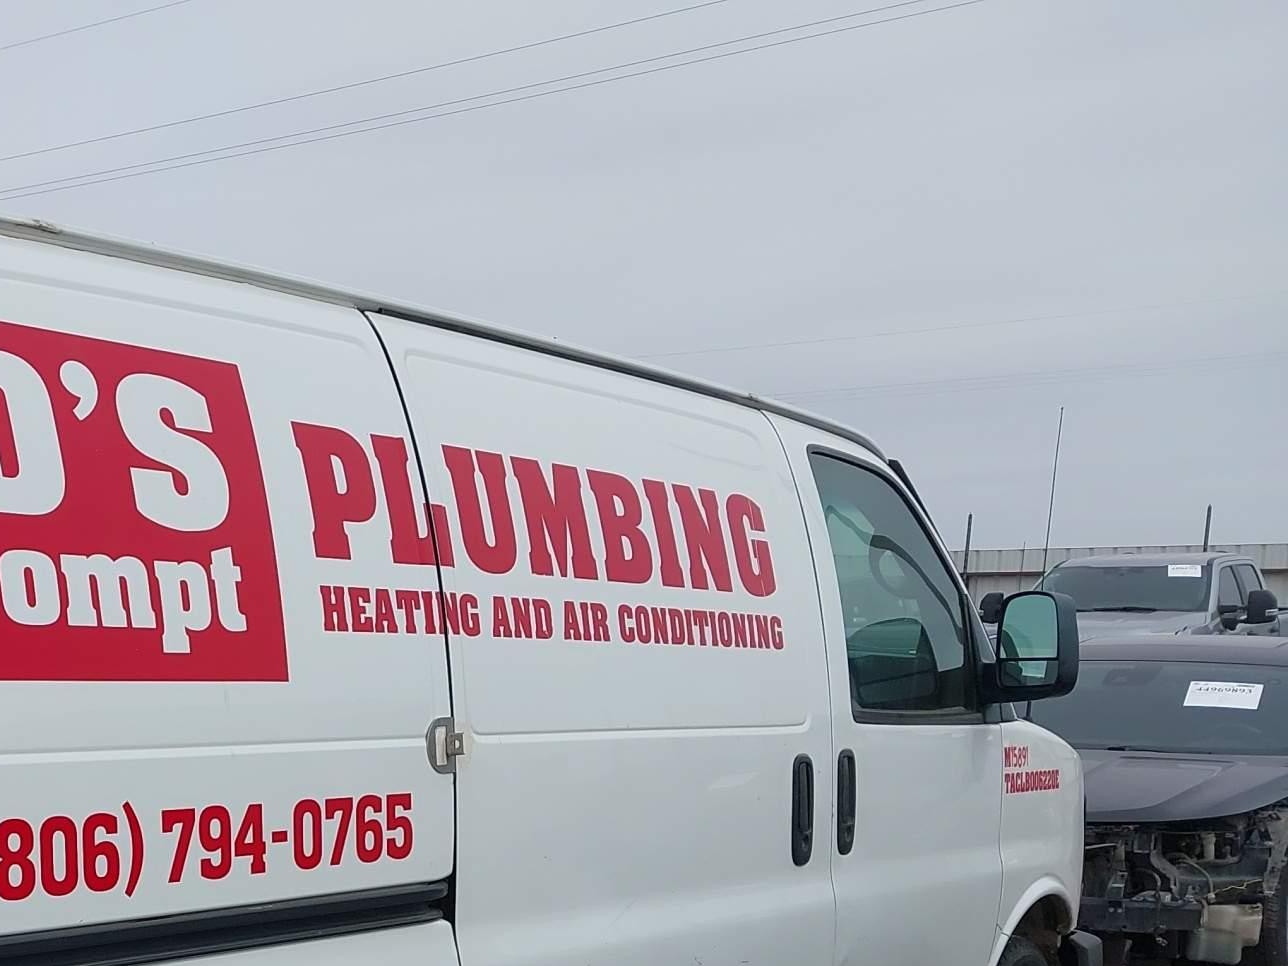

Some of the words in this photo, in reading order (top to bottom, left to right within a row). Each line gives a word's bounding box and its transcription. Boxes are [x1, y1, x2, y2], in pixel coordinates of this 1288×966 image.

[289, 419, 778, 599] PLUMBING
[318, 584, 481, 637] HEATING
[492, 595, 554, 640] AND
[564, 600, 612, 643] AIR
[617, 603, 785, 652] CONDITIONING
[160, 792, 414, 884] 794-0765
